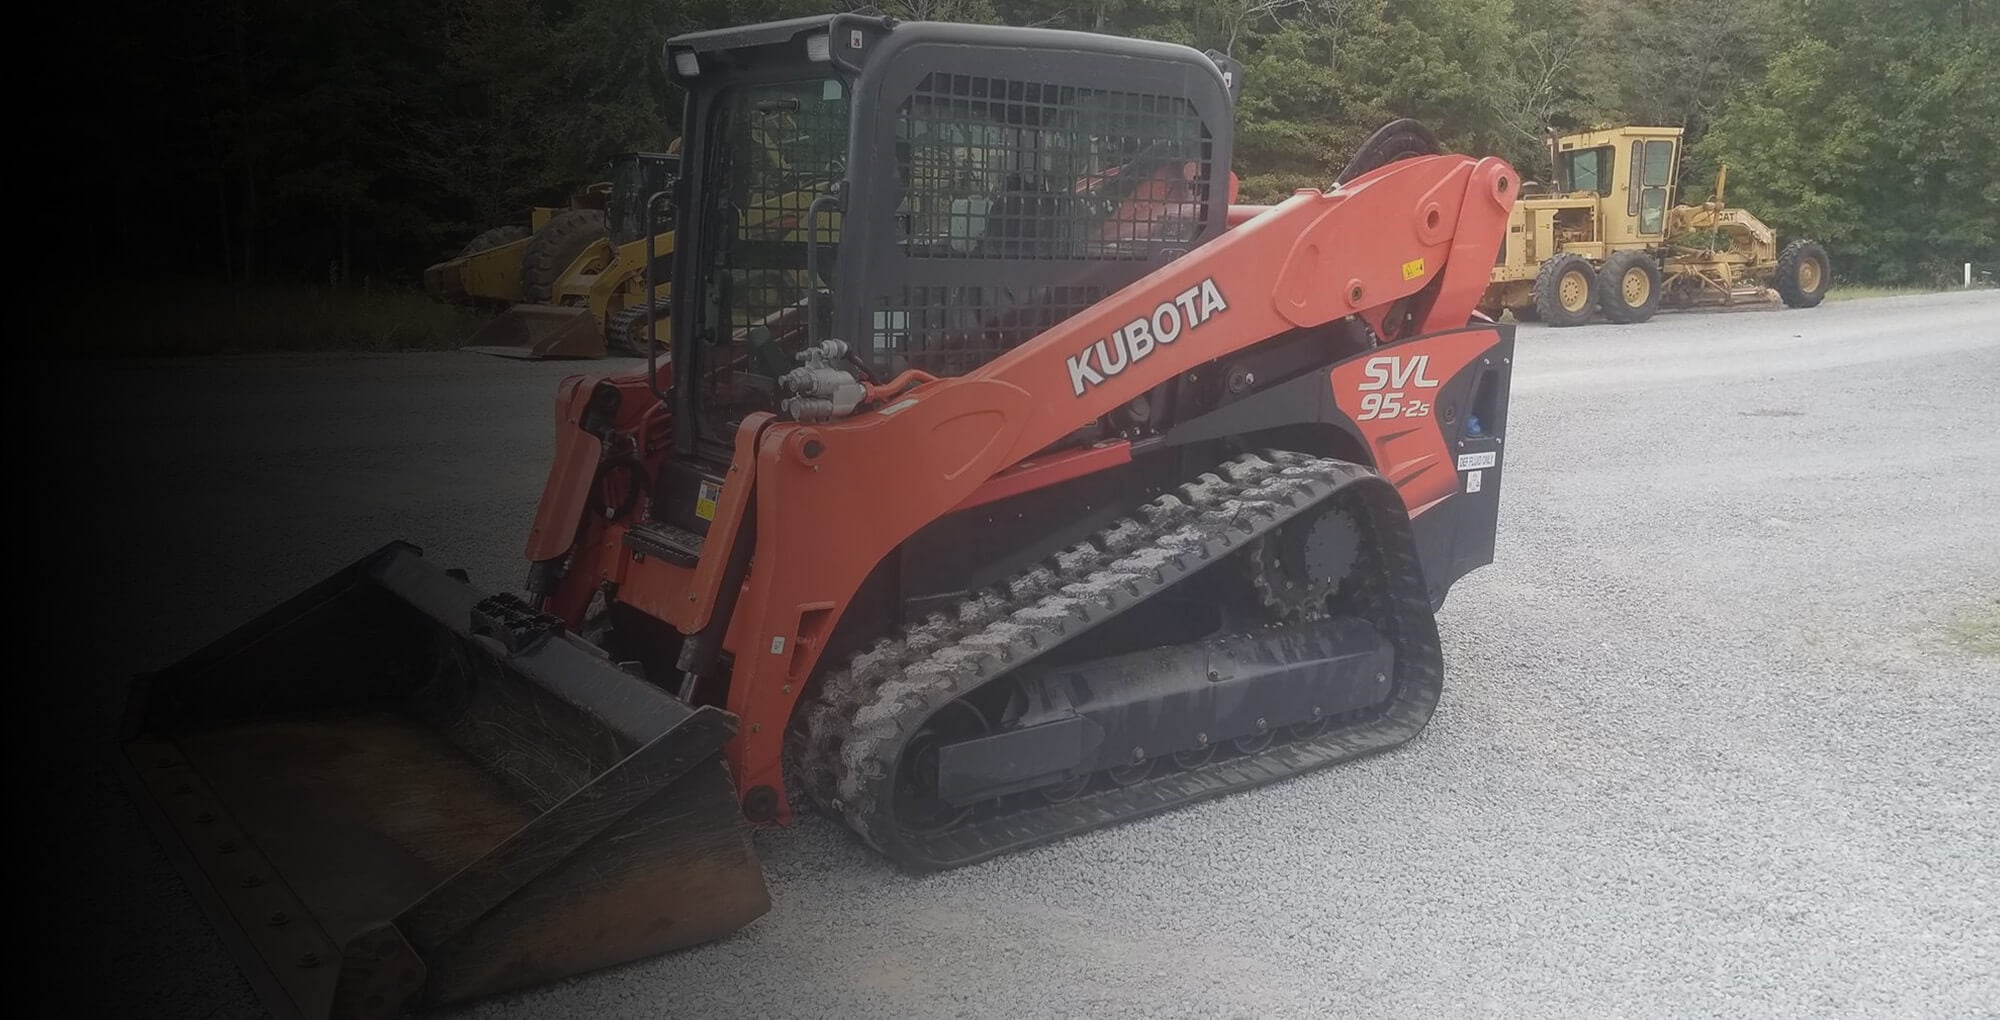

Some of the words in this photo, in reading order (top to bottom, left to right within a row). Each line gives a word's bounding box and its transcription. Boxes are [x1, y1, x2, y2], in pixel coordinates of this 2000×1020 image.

[1066, 277, 1228, 396] KUBOTA
[1358, 355, 1439, 391] SVL
[1460, 456, 1469, 468] DEF
